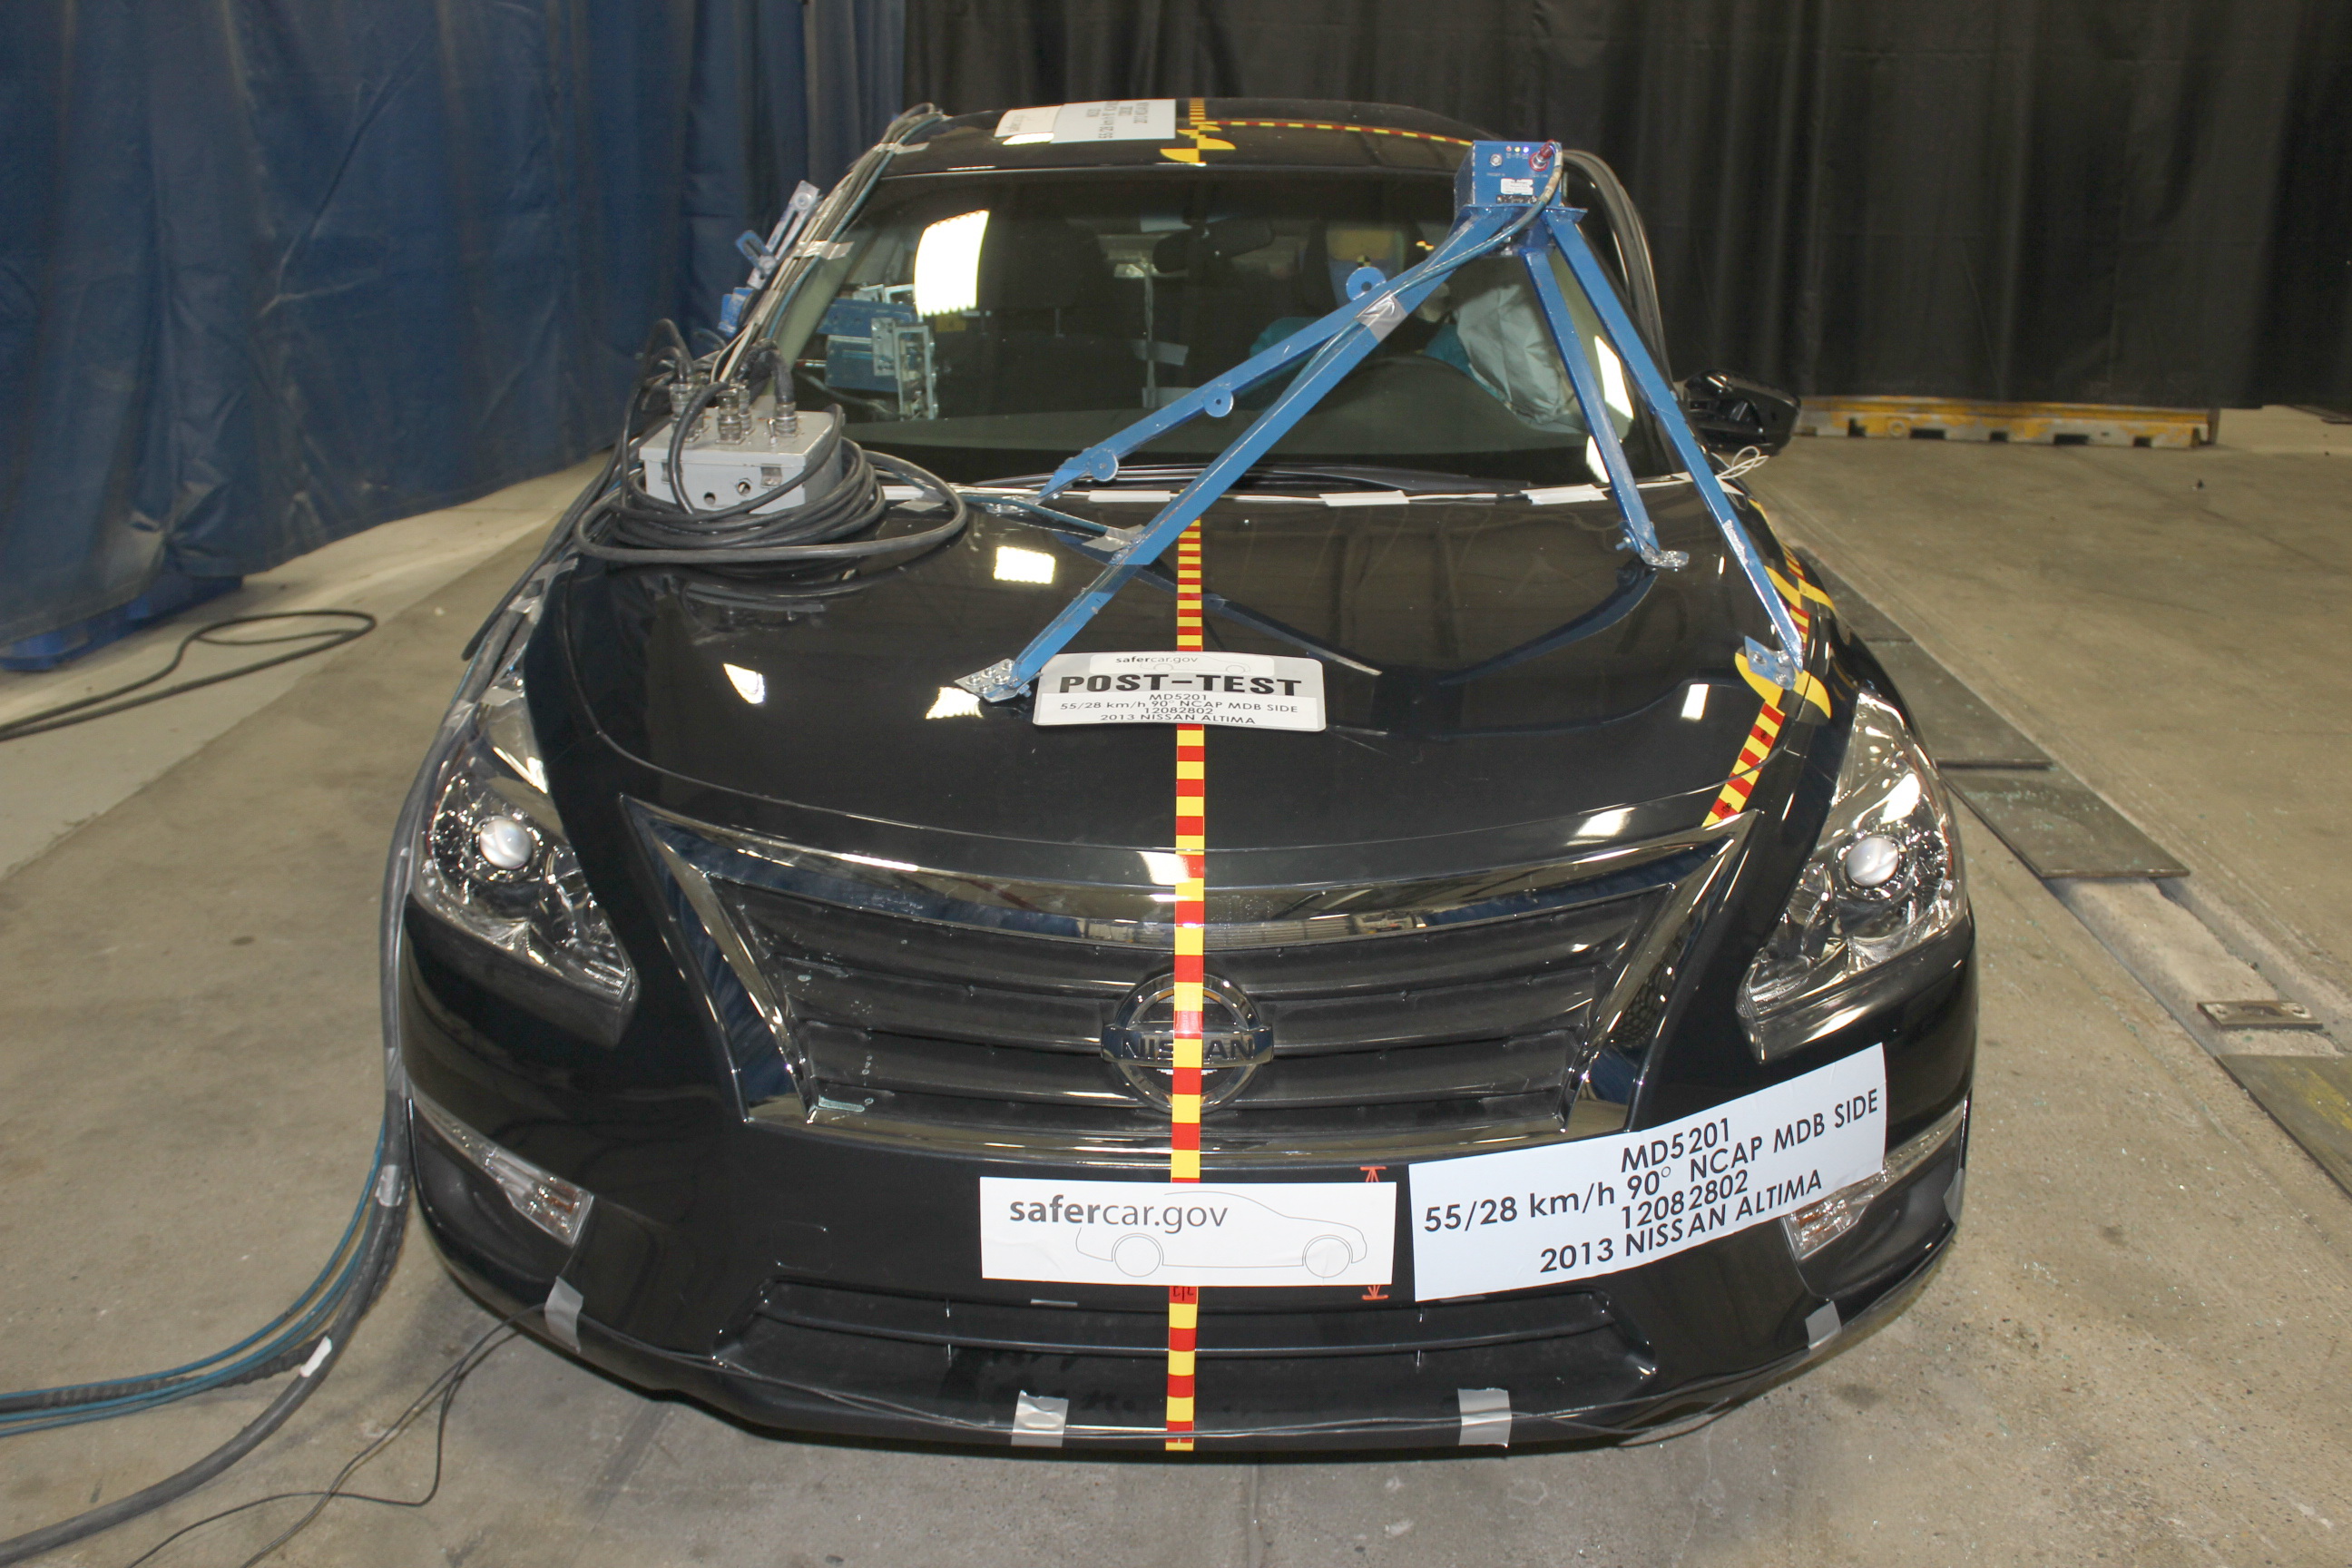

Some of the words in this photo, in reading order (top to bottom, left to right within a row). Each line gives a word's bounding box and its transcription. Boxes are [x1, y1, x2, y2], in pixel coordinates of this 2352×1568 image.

[1115, 655, 1198, 663] safercar.gov
[1059, 673, 1302, 696] POST-TEST
[1060, 701, 1102, 710] 55/28
[1179, 700, 1223, 708] NCAP
[1228, 701, 1262, 710] MDB
[1267, 704, 1298, 713] SIDE
[1200, 714, 1256, 724] ALTIMA
[1122, 1038, 1255, 1061] NISAN
[1424, 1195, 1518, 1233] 55/28
[1529, 1181, 1616, 1219] km/h
[1690, 1135, 1763, 1182] NCAP
[1773, 1112, 1826, 1154] MDB
[1834, 1087, 1878, 1129] SIDE
[1621, 1117, 1730, 1173] MD5201
[1009, 1194, 1229, 1235] safercar.gov
[1621, 1168, 1749, 1230] 12082802
[1539, 1237, 1614, 1273] 2013
[1625, 1202, 1727, 1257] NISSAN
[1734, 1168, 1823, 1221] ALTIMA
